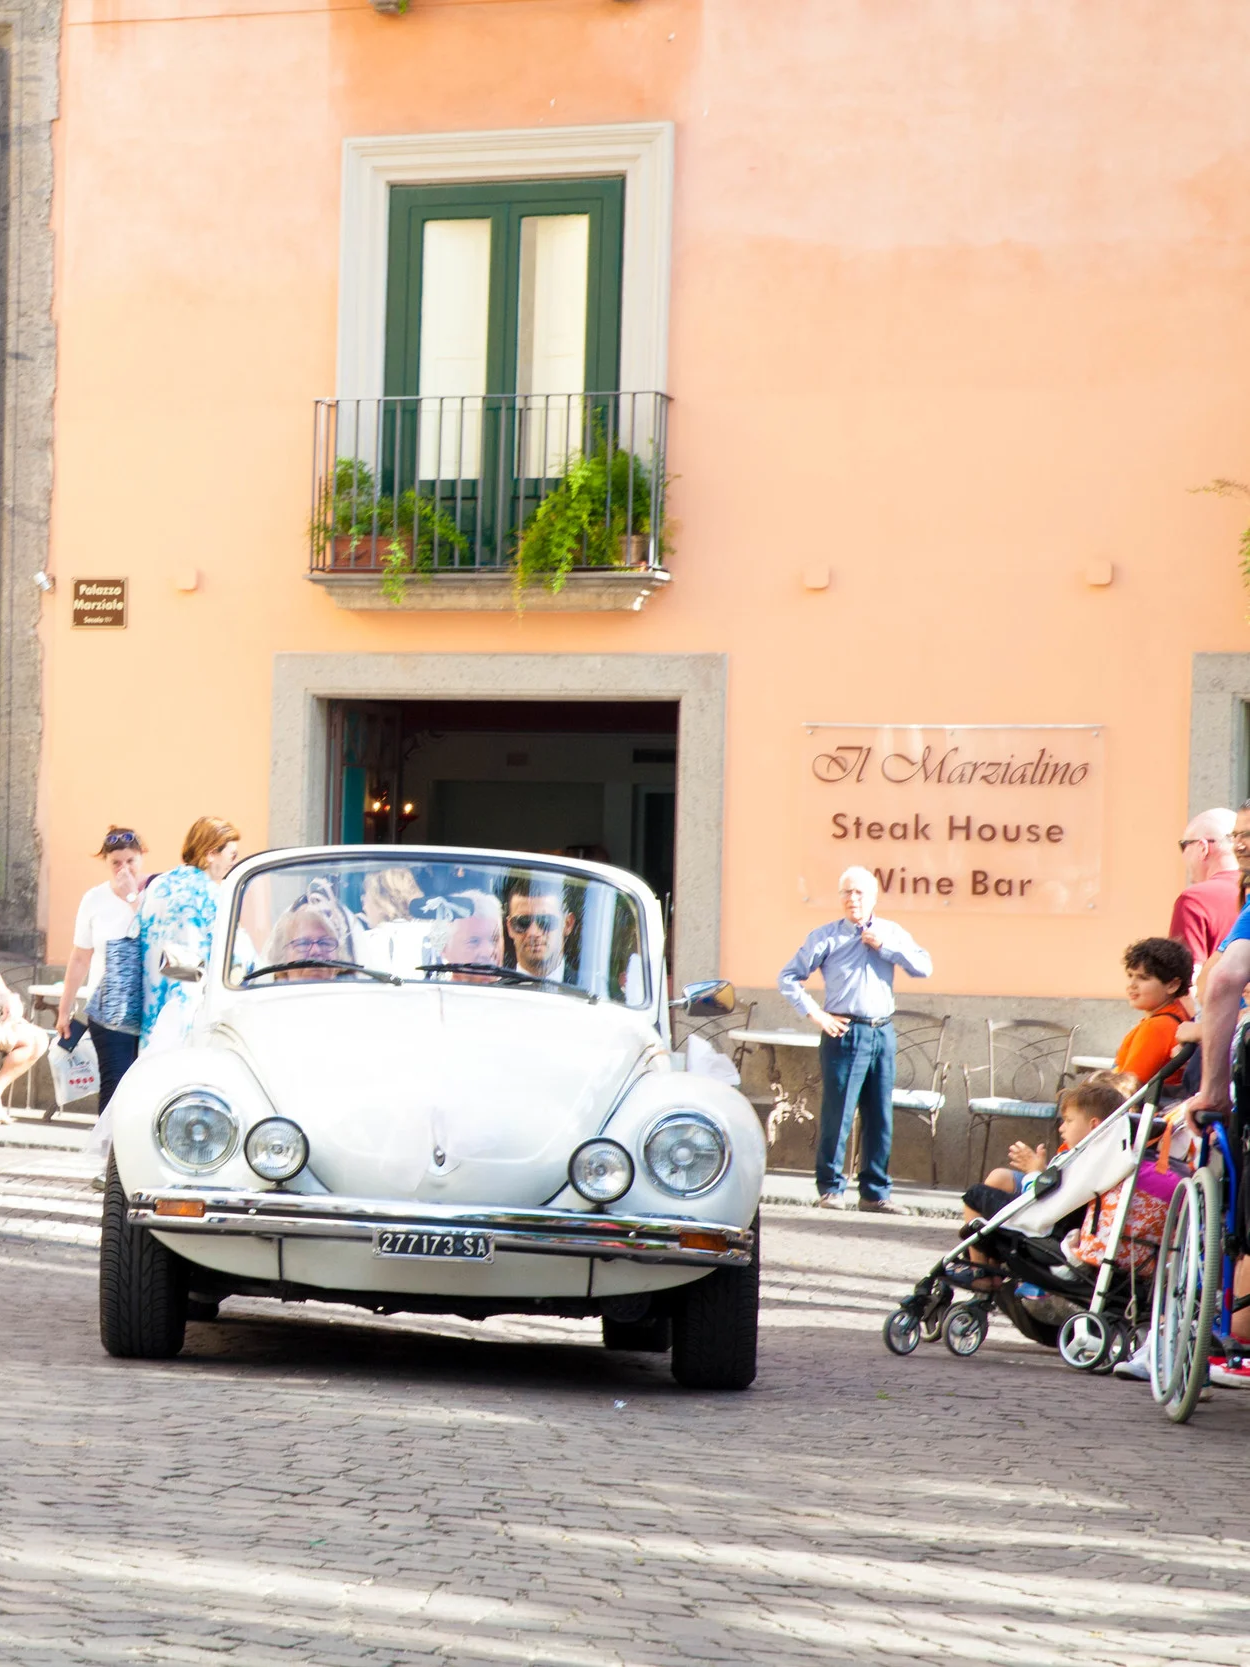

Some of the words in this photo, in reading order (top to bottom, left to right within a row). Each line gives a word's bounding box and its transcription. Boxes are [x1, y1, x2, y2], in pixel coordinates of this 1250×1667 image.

[79, 583, 122, 596] Palazzo
[73, 598, 124, 611] Marziale
[812, 746, 872, 784] Il
[881, 745, 1090, 786] Marzialino
[831, 812, 931, 841] Steak
[948, 815, 1064, 844] House
[971, 869, 1033, 897] Bar
[381, 1232, 454, 1256] 277173
[463, 1236, 487, 1257] SA
